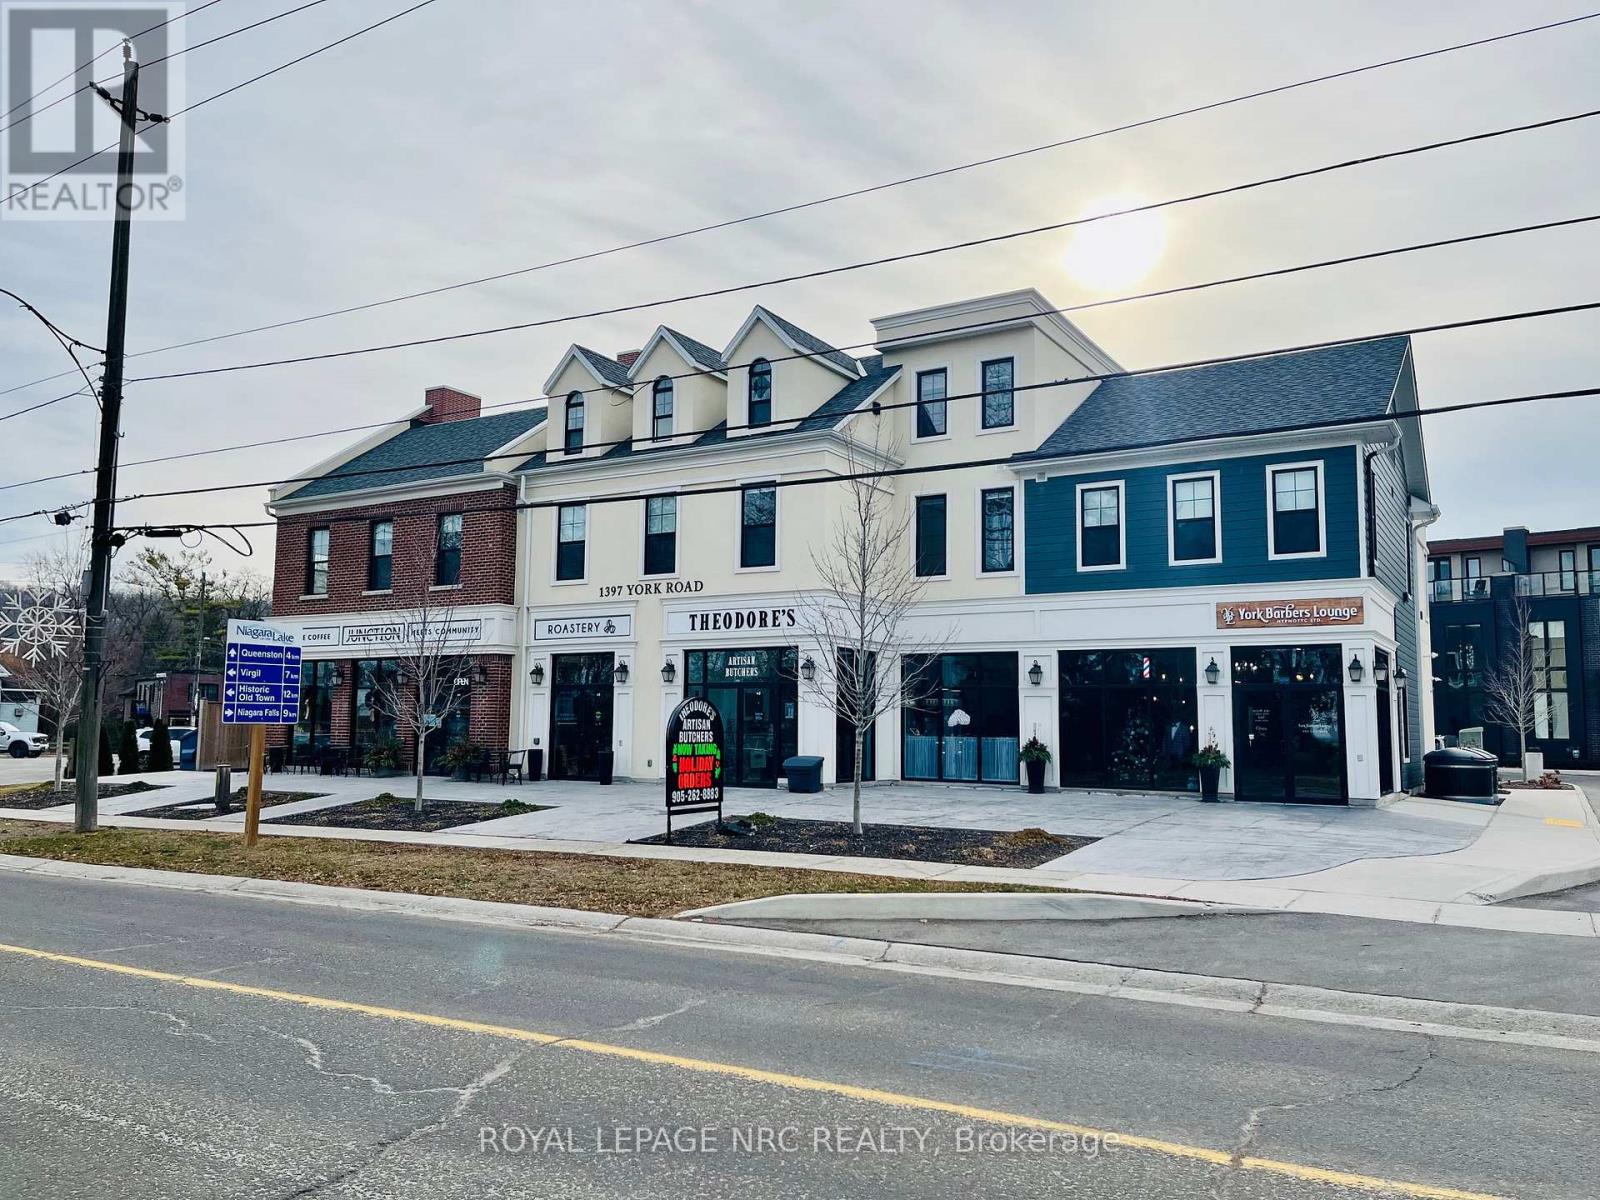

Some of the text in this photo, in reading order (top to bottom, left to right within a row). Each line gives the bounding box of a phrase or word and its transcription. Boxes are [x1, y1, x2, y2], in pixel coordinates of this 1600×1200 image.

[599, 580, 704, 597] 1397 YORK ROAD
[1238, 604, 1358, 623] York Barbers Lounge
[689, 608, 796, 631] THEODORE'S
[236, 625, 295, 642] Niagara Lake
[435, 626, 479, 635] COMMUNITY
[547, 622, 601, 634] ROASTERY
[307, 633, 331, 641] COFFEE
[346, 627, 401, 643] JUNCTION
[241, 648, 283, 659] Queenston
[728, 656, 756, 666] ARTISAN
[240, 669, 261, 679] Virgil
[285, 671, 290, 679] 7
[725, 667, 759, 677] BUTCHERS
[239, 684, 270, 693] Historic
[283, 690, 292, 698] 12
[239, 693, 275, 702] Old Town
[237, 708, 263, 717] Niagara
[264, 708, 280, 716] Falls
[283, 709, 289, 717] 9
[682, 719, 711, 730] ARTISAN
[679, 731, 714, 742] BUTCHERS
[677, 743, 717, 755] NOW TAKING
[679, 756, 714, 772] HOLIDAY
[678, 772, 712, 789] ORDERS
